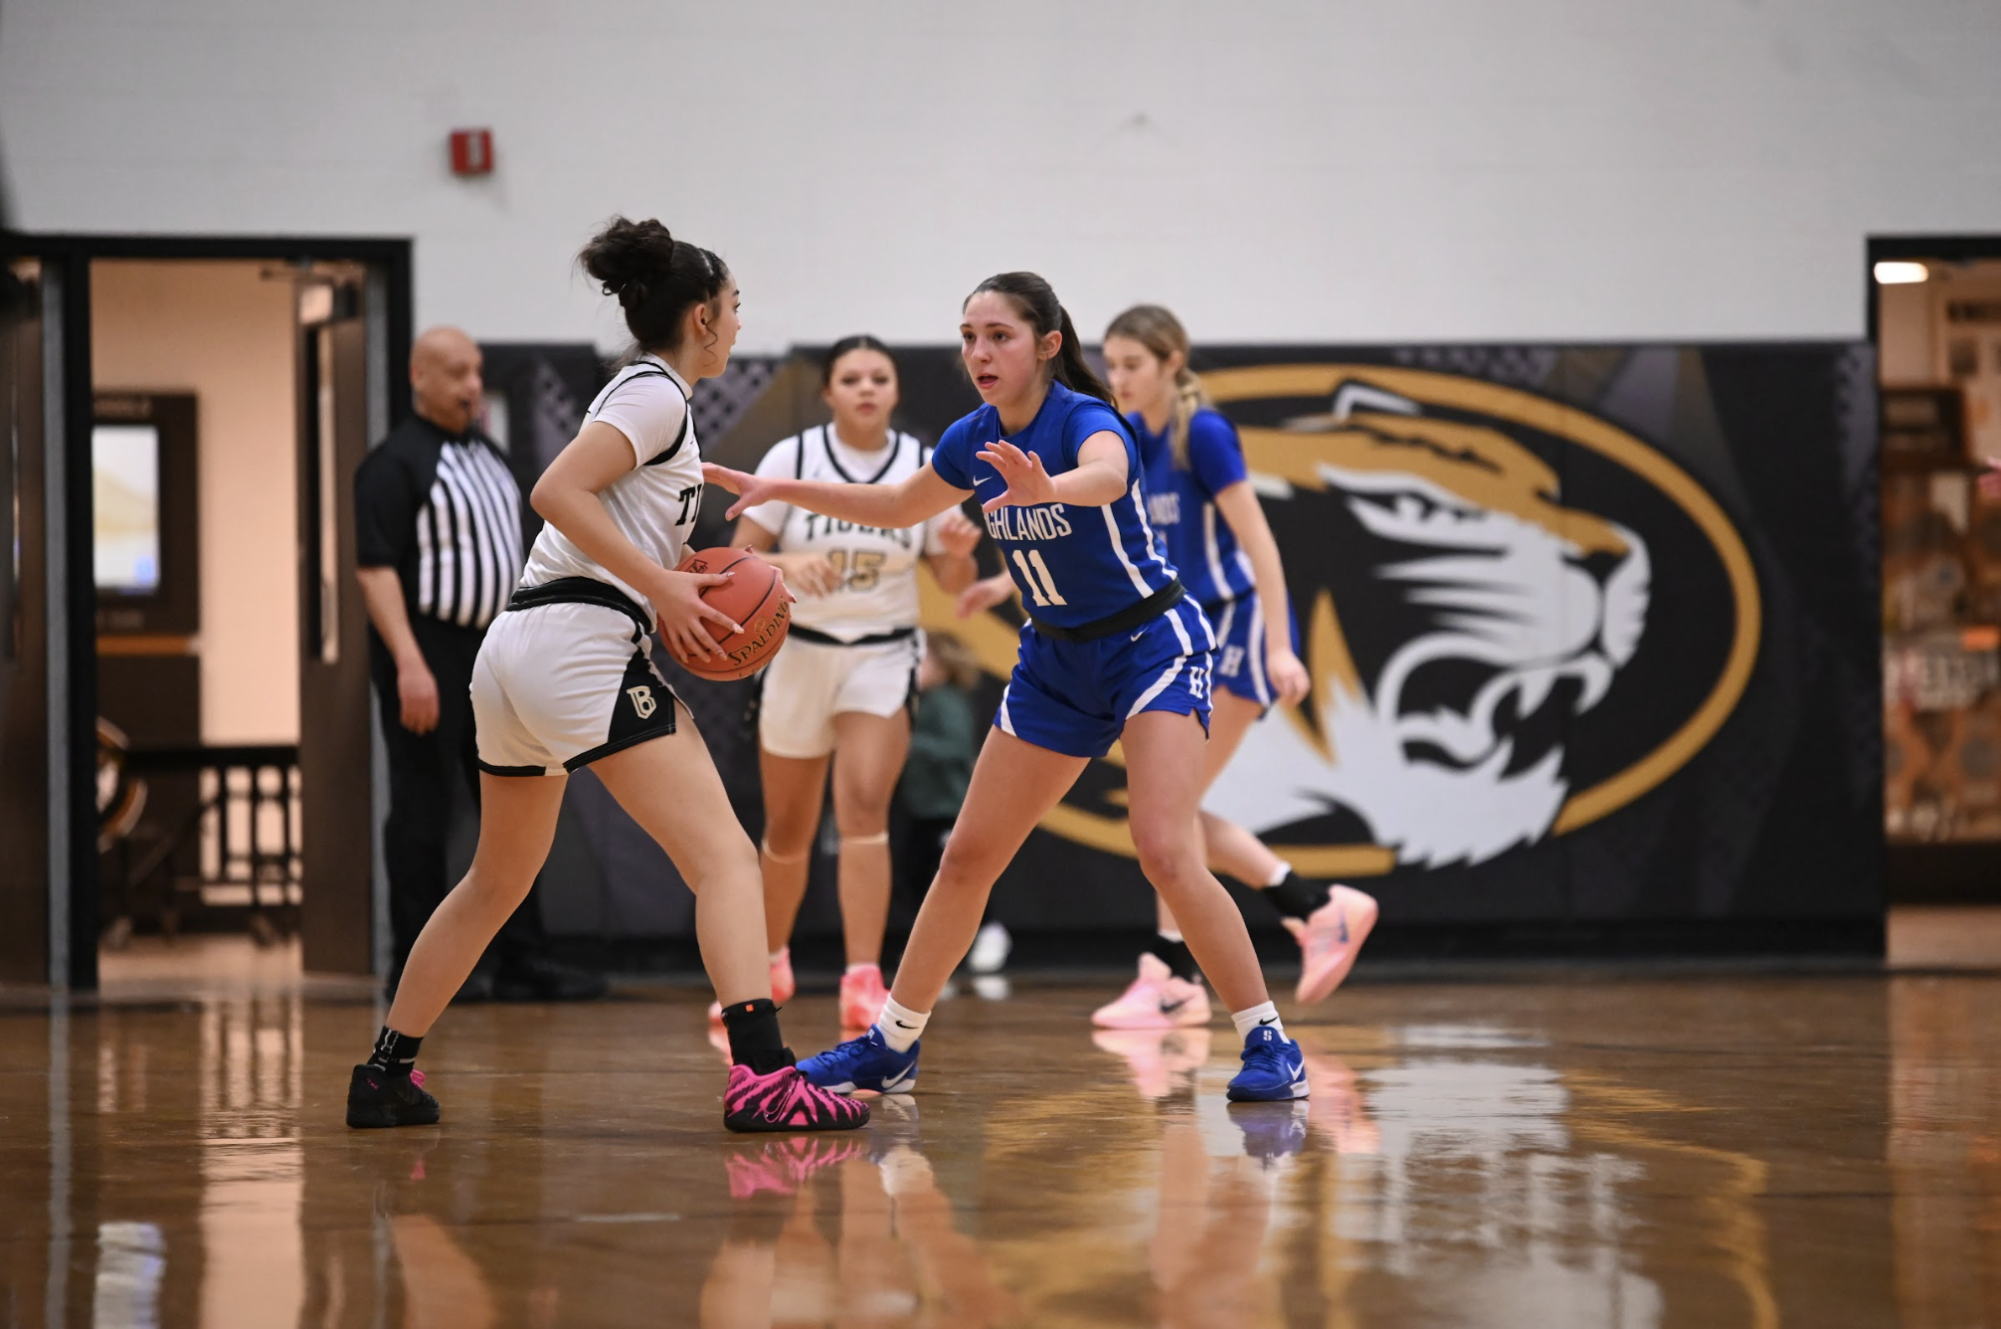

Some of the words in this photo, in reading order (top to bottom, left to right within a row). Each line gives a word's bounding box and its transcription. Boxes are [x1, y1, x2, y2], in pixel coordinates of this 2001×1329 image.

[983, 503, 1072, 540] GHLANDS
[1012, 549, 1068, 606] 11
[728, 599, 789, 666] SPALDING
[1189, 666, 1205, 699] H
[626, 685, 657, 719] B
